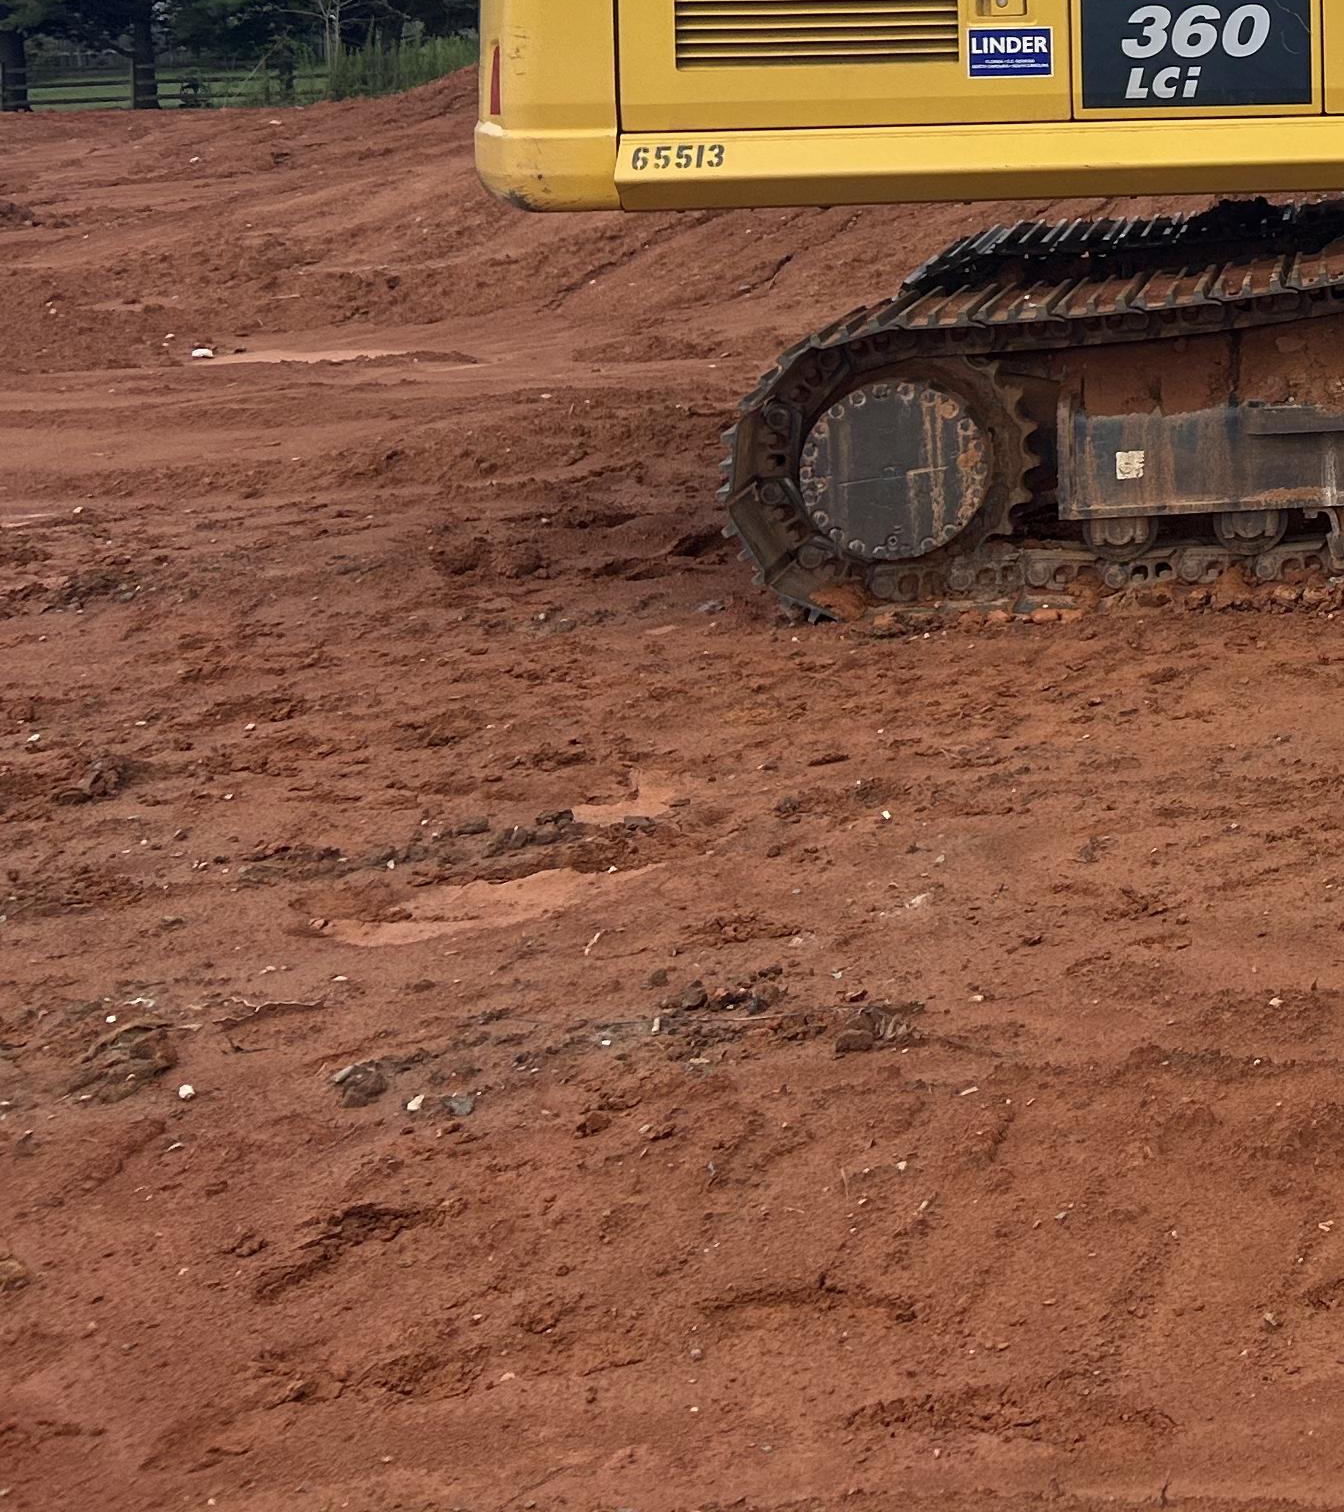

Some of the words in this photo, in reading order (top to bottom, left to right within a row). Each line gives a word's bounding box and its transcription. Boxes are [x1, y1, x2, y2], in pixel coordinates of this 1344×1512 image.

[971, 36, 1049, 54] LINDER
[1121, 4, 1271, 59] 360
[1125, 66, 1201, 99] LCi
[631, 144, 726, 170] 65513
